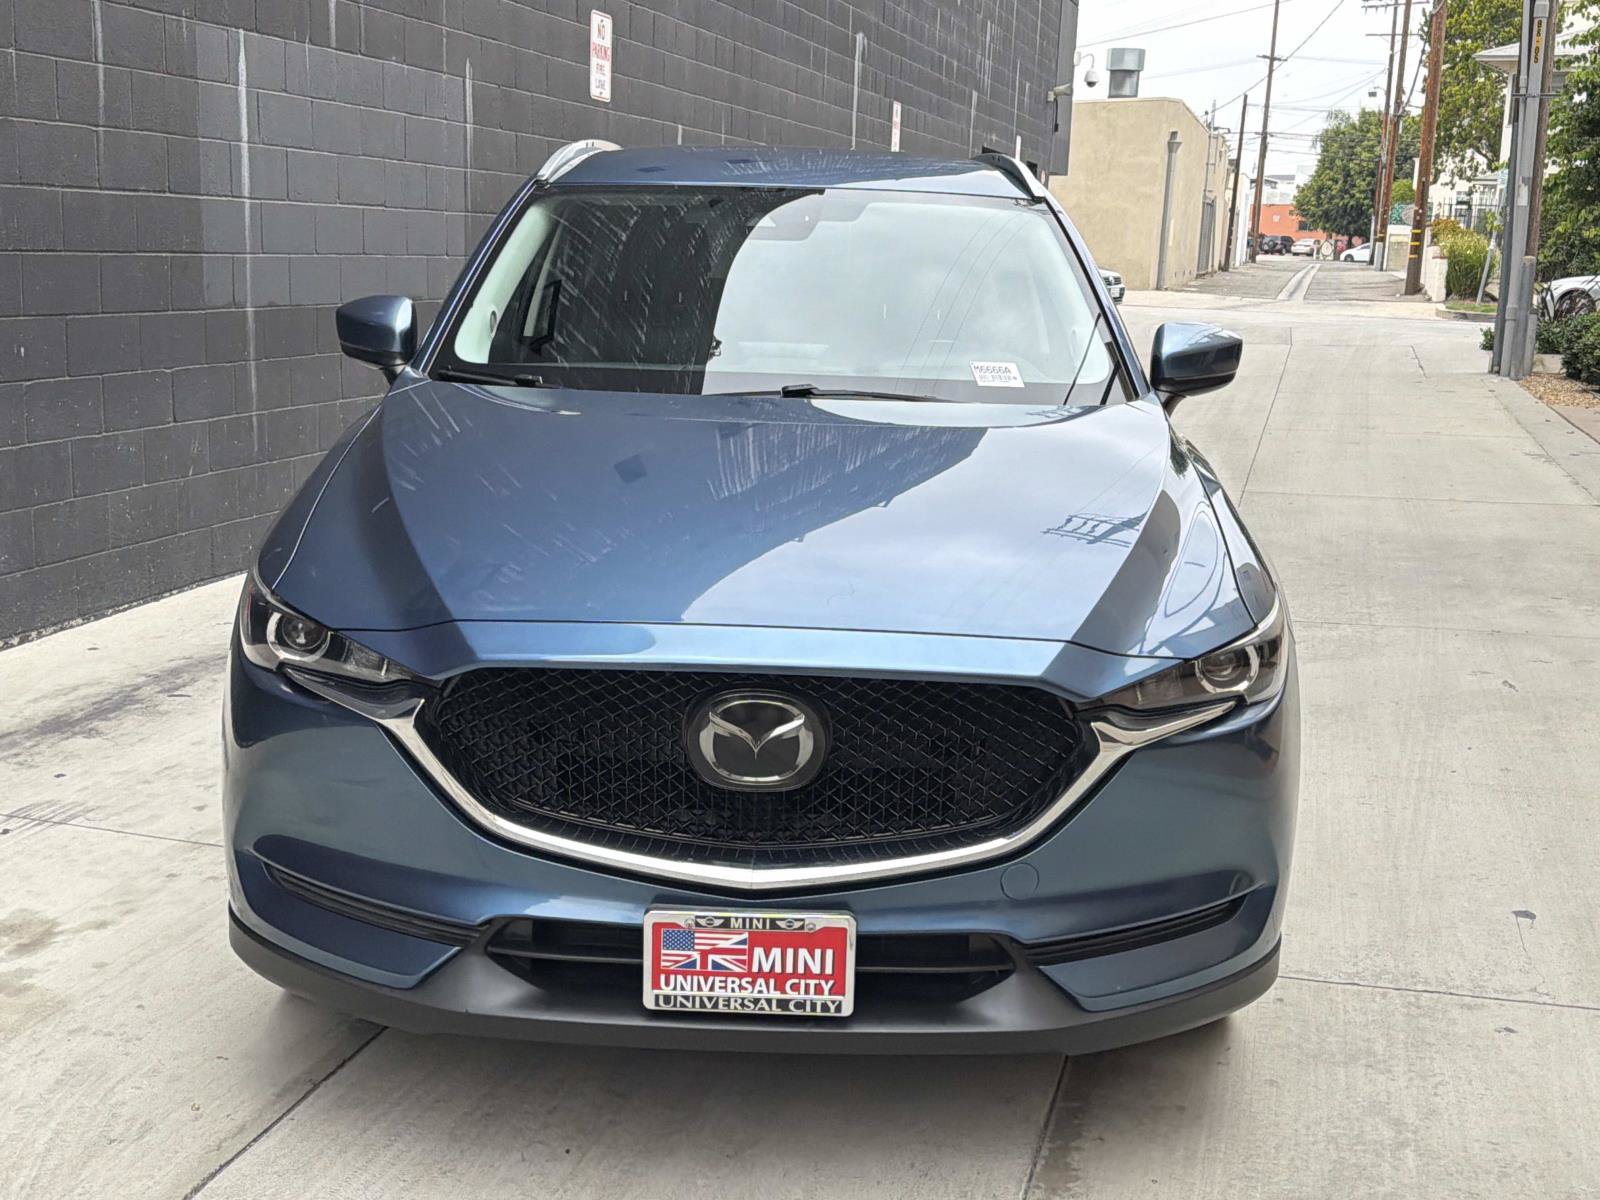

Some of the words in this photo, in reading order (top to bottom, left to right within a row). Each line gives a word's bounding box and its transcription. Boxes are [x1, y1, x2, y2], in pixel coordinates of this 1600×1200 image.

[597, 23, 606, 40] NO
[730, 917, 770, 930] MINI
[752, 947, 835, 975] MINI
[659, 974, 781, 994] UNIVERSAL
[785, 978, 835, 996] CITY
[658, 995, 782, 1012] UNIVERSAL
[789, 1000, 842, 1014] CITY
